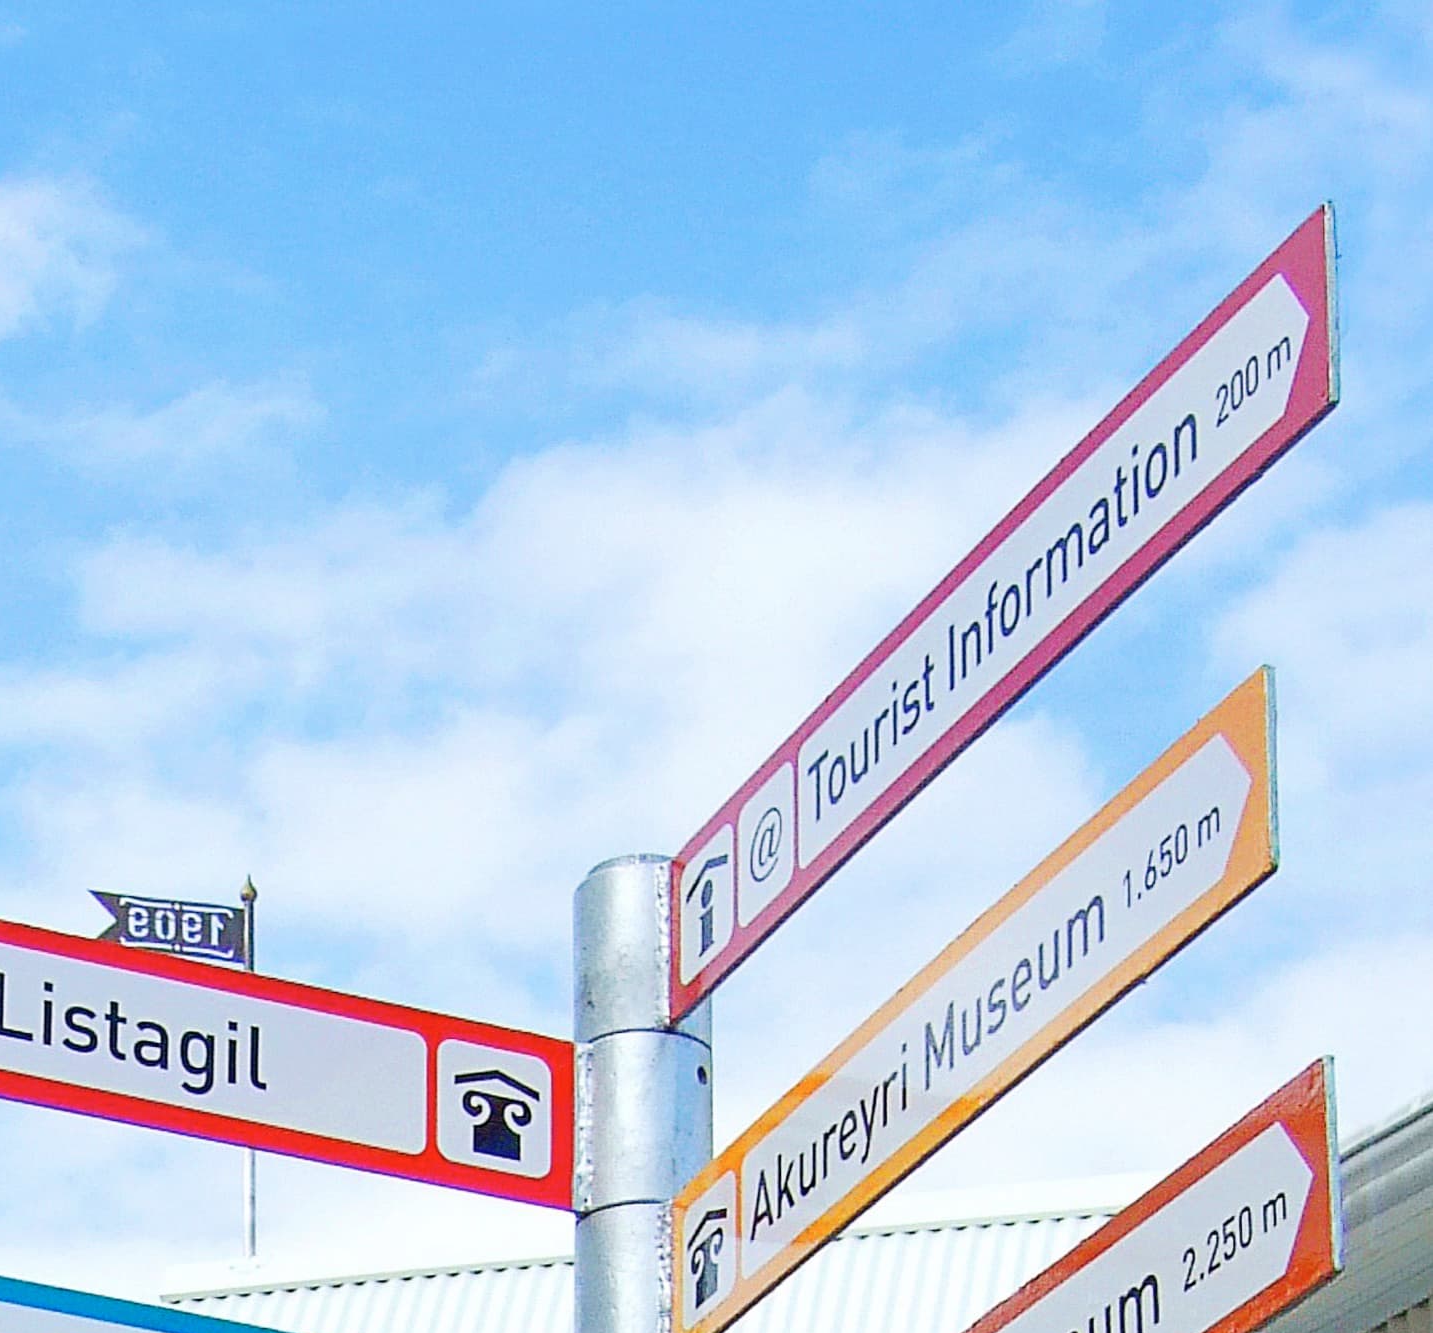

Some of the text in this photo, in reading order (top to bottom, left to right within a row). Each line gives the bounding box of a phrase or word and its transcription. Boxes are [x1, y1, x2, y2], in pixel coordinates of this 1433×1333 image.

[807, 654, 935, 826] Tourist
[948, 413, 1197, 692] Information
[1216, 355, 1259, 428] 200
[1267, 336, 1291, 380] m
[750, 806, 1220, 1241] Akureyri Museum 1.650 m
[1182, 1205, 1253, 1293] 2.250
[1262, 1192, 1287, 1233] m
